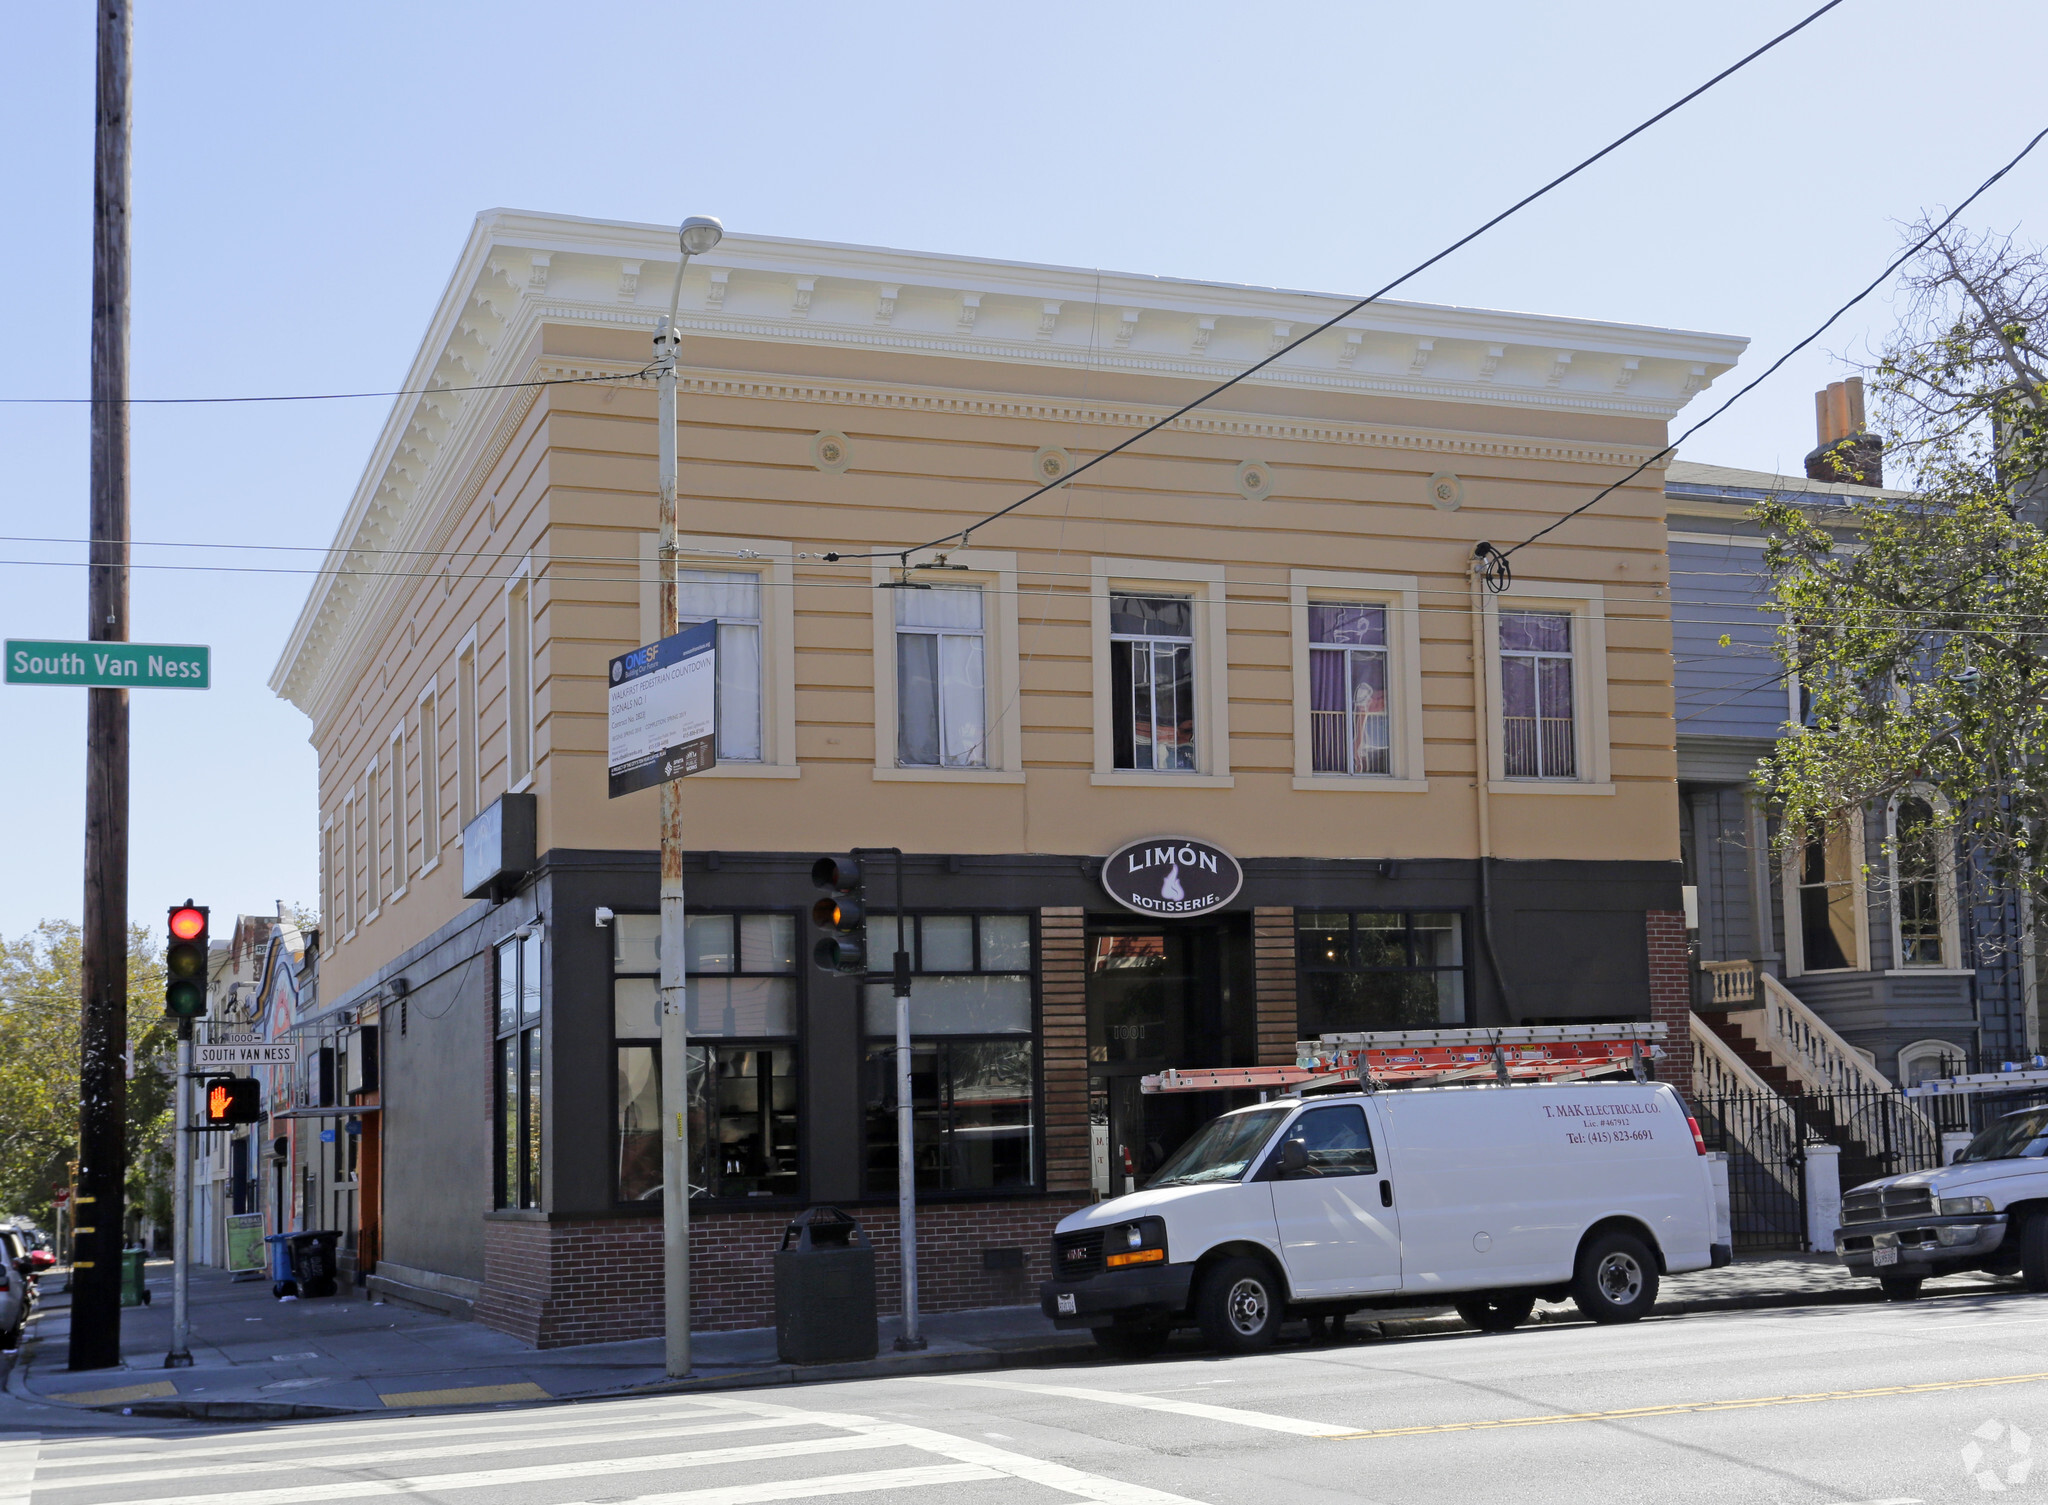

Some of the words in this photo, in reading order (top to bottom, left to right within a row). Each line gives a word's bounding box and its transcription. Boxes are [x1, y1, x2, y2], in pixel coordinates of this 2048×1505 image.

[13, 651, 85, 675] South
[93, 653, 138, 676] Van
[148, 655, 201, 678] Ness
[625, 644, 659, 670] ONESF
[638, 664, 647, 673] Our
[646, 661, 659, 670] Future
[611, 683, 639, 701] WALKFIRST
[640, 672, 671, 691] PEDESTRIAN
[671, 656, 712, 680] COUNTDOWN
[611, 697, 633, 716] SIGNALS
[611, 718, 628, 729] Contract
[1128, 842, 1217, 874] LIMÓN
[1132, 893, 1215, 911] ROTISSERIE
[230, 1034, 253, 1043] 1000
[1114, 1025, 1145, 1039] 1001
[202, 1048, 235, 1061] SOUTH
[240, 1048, 260, 1060] VAN
[264, 1047, 290, 1060] NESS
[1543, 1105, 1555, 1118] T.
[1556, 1104, 1585, 1117] MAK
[1584, 1103, 1644, 1116] ELECTRICAL
[1645, 1103, 1661, 1114] CO.
[1583, 1119, 1599, 1128] Lic.
[1566, 1132, 1586, 1144] Tel:
[1587, 1131, 1612, 1145] (415)
[1613, 1129, 1654, 1142] 823-6691
